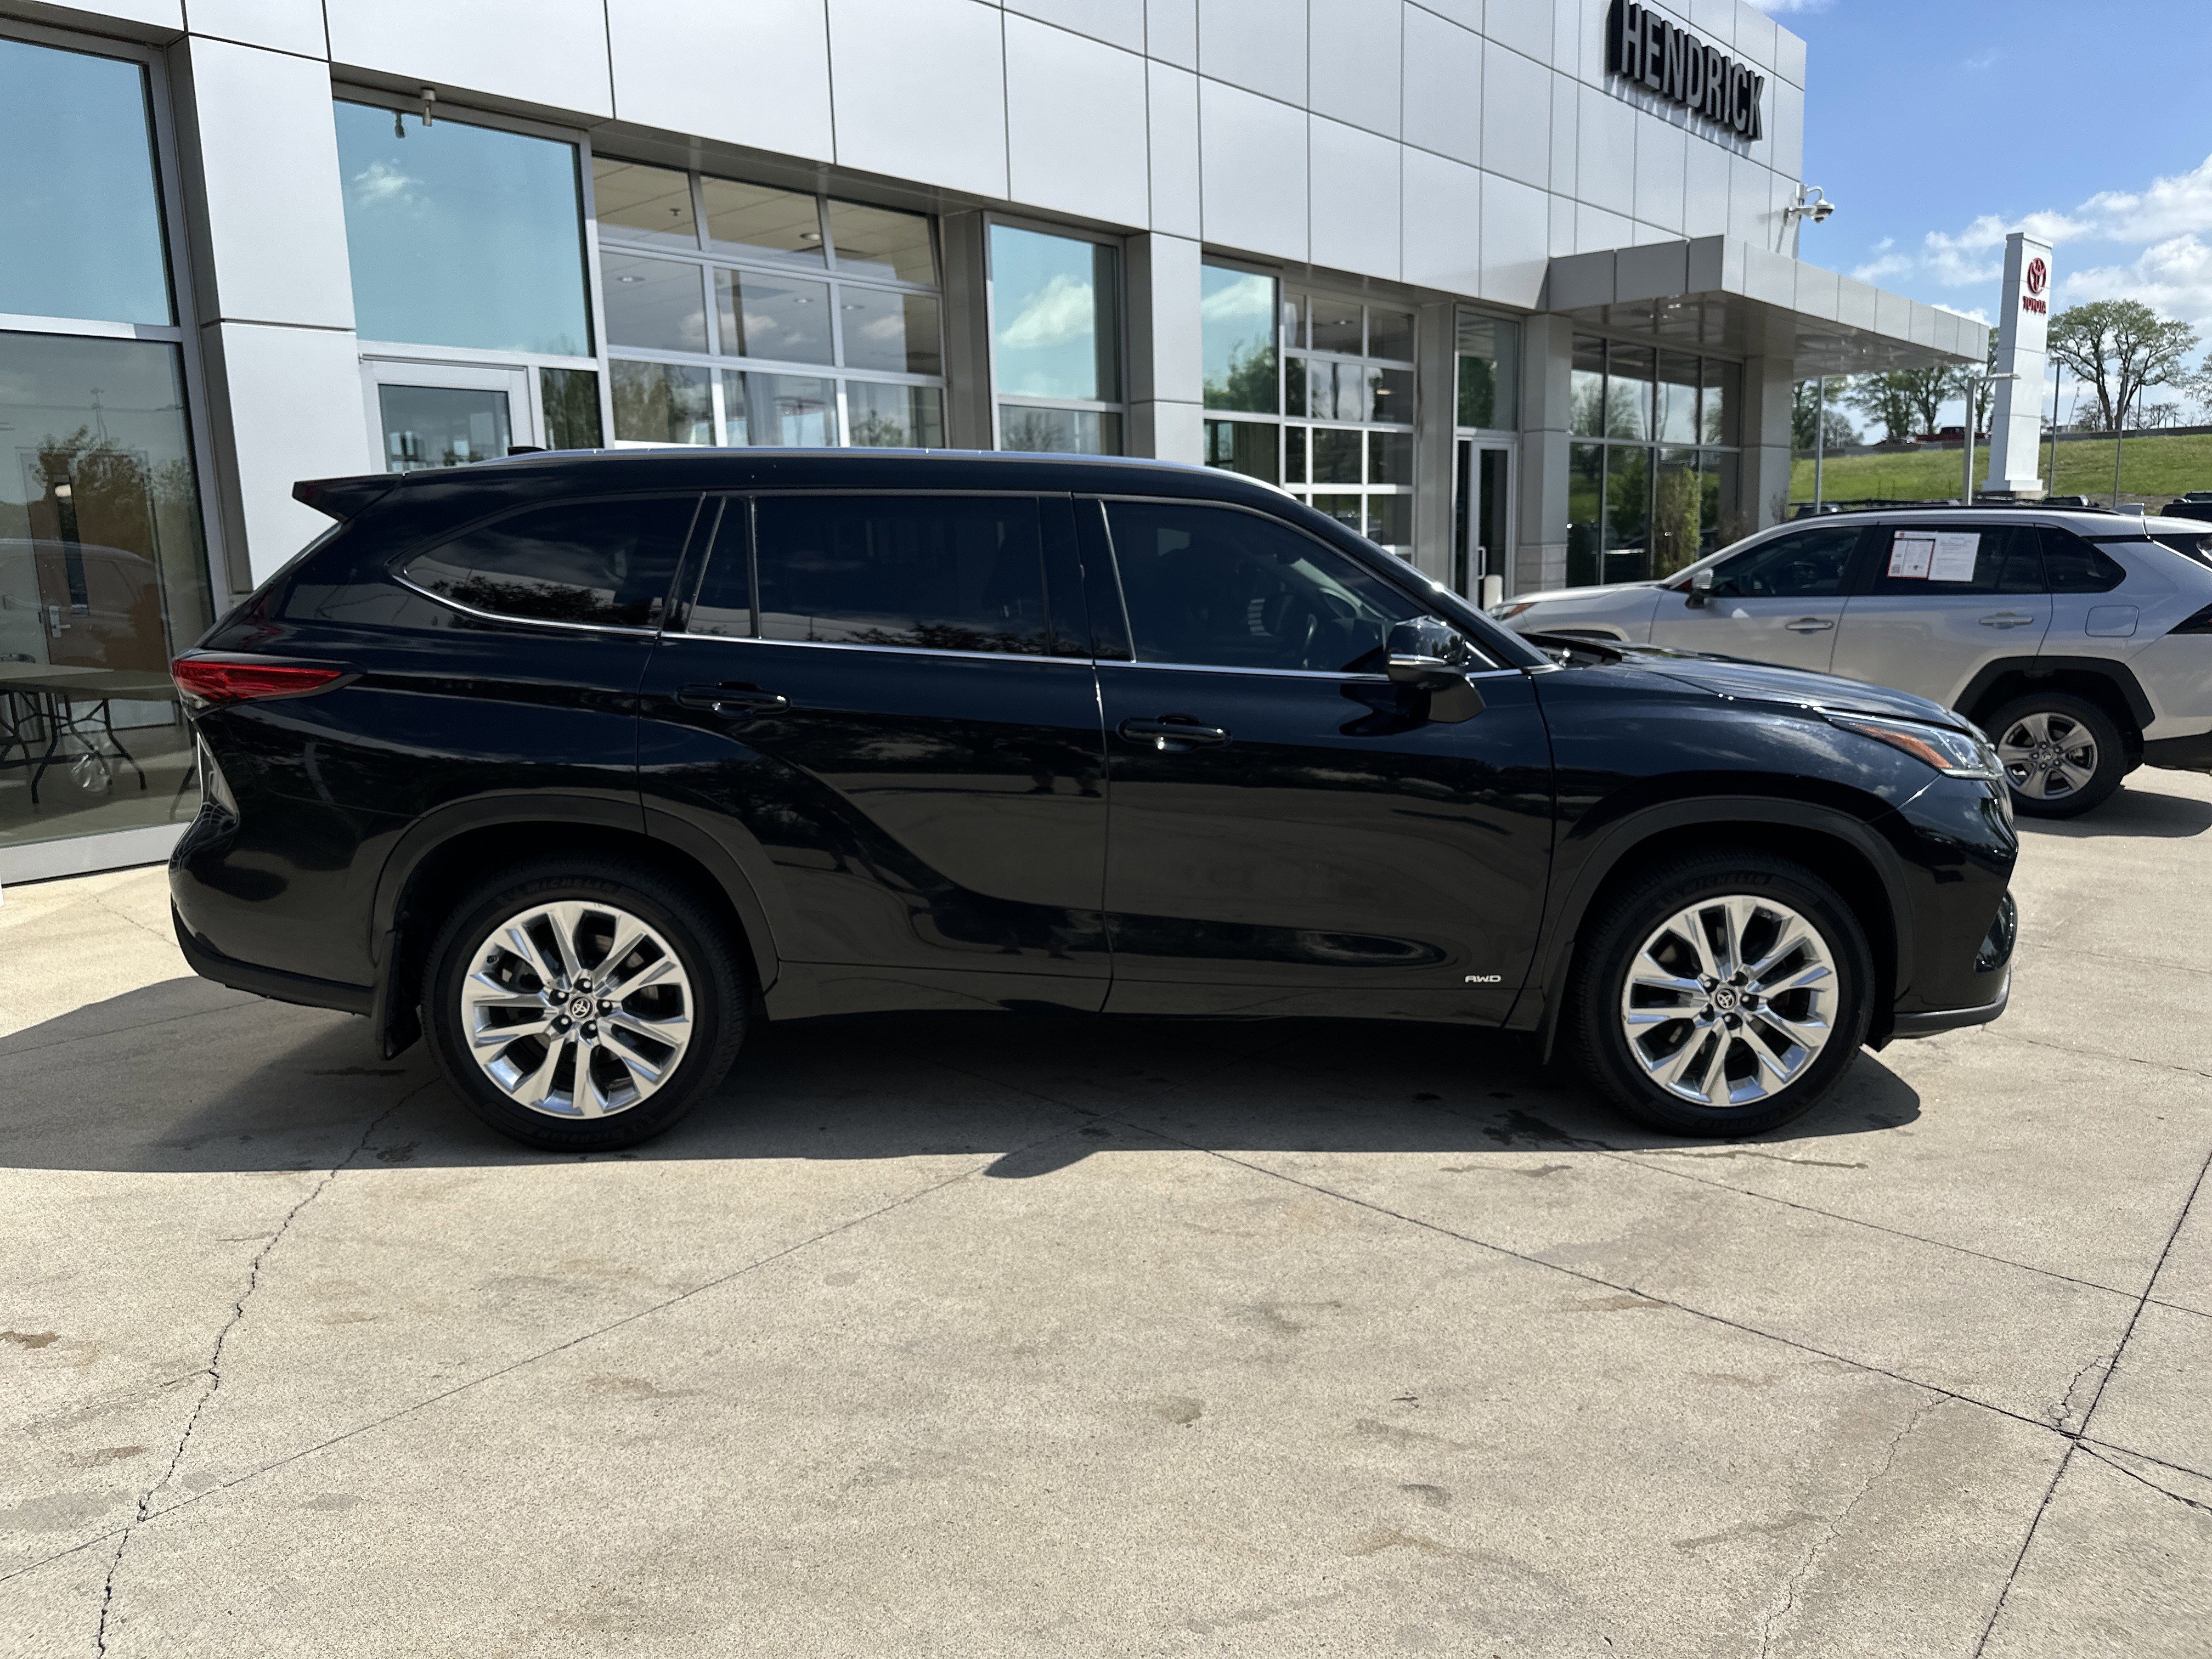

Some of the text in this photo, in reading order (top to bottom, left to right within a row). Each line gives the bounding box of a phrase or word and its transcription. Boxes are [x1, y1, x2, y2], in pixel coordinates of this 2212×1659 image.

[1607, 0, 1764, 140] HENDRICK
[2022, 296, 2046, 313] TOYOTA
[1464, 975, 1502, 983] AWD
